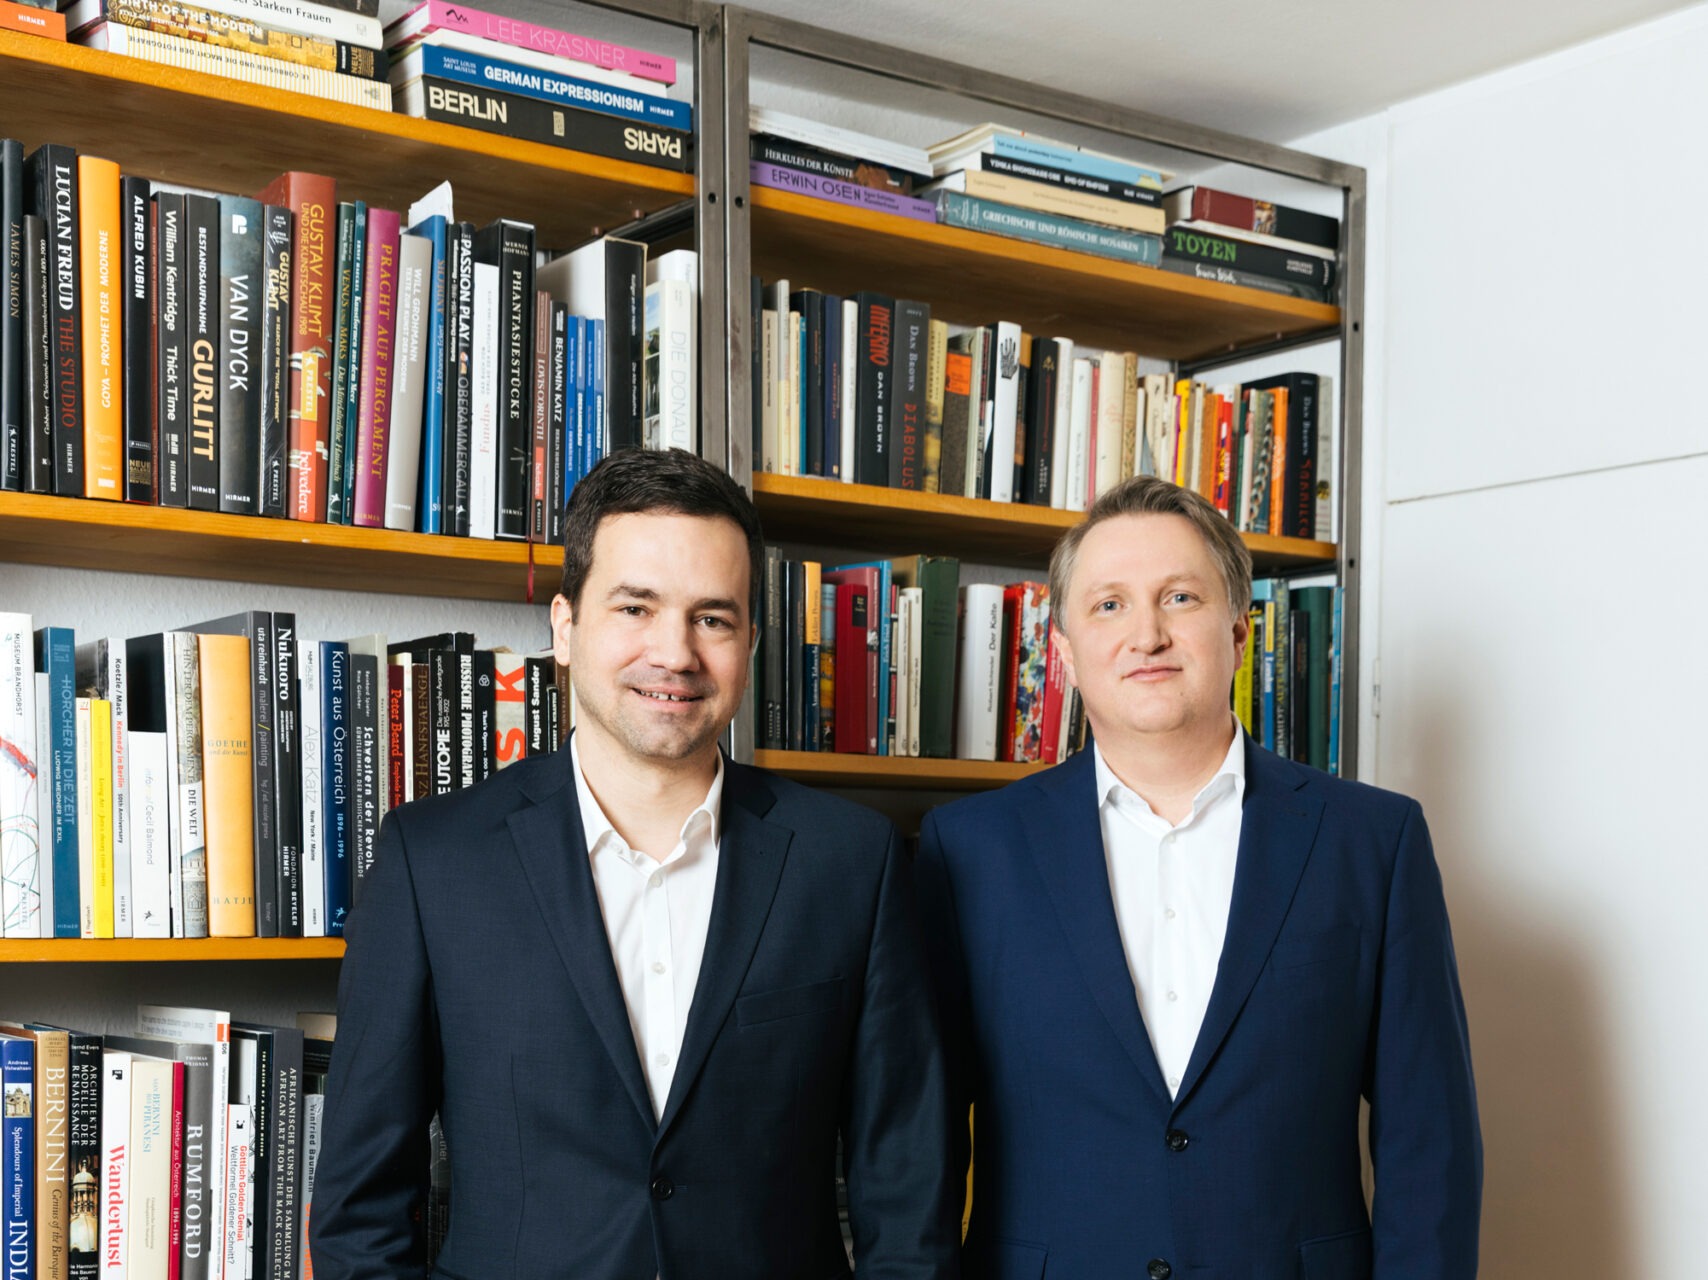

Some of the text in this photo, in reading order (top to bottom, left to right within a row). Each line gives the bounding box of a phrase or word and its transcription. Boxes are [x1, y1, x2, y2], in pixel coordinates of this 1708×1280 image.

[18, 14, 46, 26] HIRMER
[252, 0, 332, 24] Starken Frauen
[486, 16, 626, 67] LEE KRASNER
[428, 86, 508, 124] BERLIN
[484, 65, 644, 113] GERMAN EXPRESSIONISM
[649, 106, 675, 117] HIRMER
[623, 127, 682, 159] PARIS
[764, 148, 854, 178] HERKULES DER KÜNSTE
[771, 169, 861, 201] ERWIN OSEN
[134, 195, 145, 300] ALFRED KUBIN
[982, 209, 1139, 253] GRIECHISCHE UND RÖMISCHE MOSAIKEN
[1172, 231, 1237, 263] TOYEN
[268, 268, 279, 311] KLIMT
[279, 251, 289, 304] GUSTAV
[300, 202, 310, 336] UND DIE KUNSTSCHAU 1908
[308, 203, 325, 338] GUSTAV KLIMT
[459, 239, 471, 342] PASSION PLAY
[55, 164, 76, 428] LUCIAN FREUD THE STUDIO
[164, 210, 179, 421] William Kentridge Thick Time
[193, 227, 214, 460] BESTANDSAUFNAHME GURLITT
[229, 274, 249, 391] VAN DYCK
[510, 270, 523, 420] PHANTASIESTÜCKE
[864, 304, 891, 368] INFERNO
[371, 244, 393, 480] PRACHT AUF PERGAMENT
[901, 325, 920, 488] DAN BROWN DIABOLUS
[456, 376, 469, 500] OBERAMMERGAU
[298, 451, 313, 513] belvedere
[278, 627, 292, 701] Nukuoro
[332, 650, 345, 691] Kunst
[1264, 656, 1274, 693] London
[258, 627, 270, 767] uta reinhardt malerei painting
[333, 697, 342, 720] aus
[391, 688, 402, 720] Peter
[531, 665, 542, 750] August Sander
[391, 723, 403, 757] Beard
[415, 670, 429, 776] HANFSTAENGL
[62, 674, 75, 825] HORCHER IN DIE ZEIT
[332, 727, 348, 804] Österreich
[437, 729, 451, 785] UTOPIE
[188, 789, 198, 836] DIE WELT
[336, 813, 344, 831] 1896
[279, 1070, 287, 1117] AFRICAN
[287, 1067, 297, 1145] AFRIKANISCHE
[12, 1126, 23, 1172] Splendours
[278, 1120, 286, 1140] ART
[14, 1174, 23, 1183] of
[46, 1066, 66, 1280] BERNINI Genius of the Baroque
[277, 1144, 285, 1172] FROM
[286, 1148, 295, 1182] KUNST
[12, 1184, 23, 1218] Imperial
[108, 1144, 125, 1269] Wanderlust
[186, 1123, 204, 1259] RUMFORD
[276, 1175, 284, 1196] THE
[285, 1186, 294, 1207] DER
[275, 1199, 283, 1228] MACK
[283, 1209, 293, 1267] SAMMLUNG
